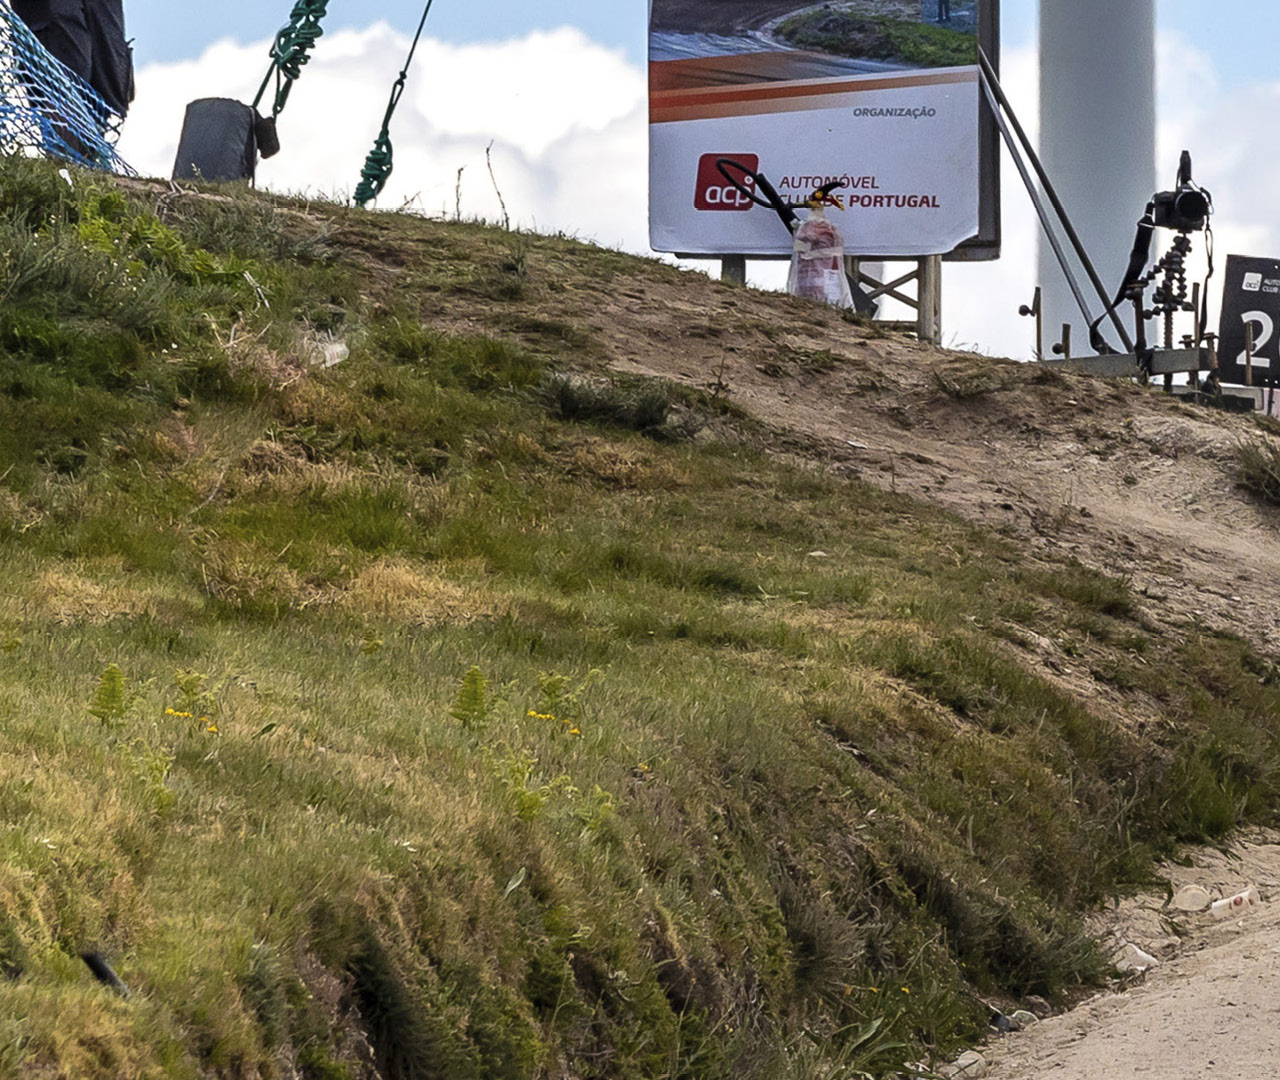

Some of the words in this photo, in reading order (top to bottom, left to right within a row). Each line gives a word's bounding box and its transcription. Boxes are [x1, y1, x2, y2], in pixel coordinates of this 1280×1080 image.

[853, 106, 936, 119] ORGANIZAÇÃO
[779, 173, 880, 189] AUTOMÓVEL
[705, 185, 752, 207] acp
[849, 194, 941, 208] PORTUGAL
